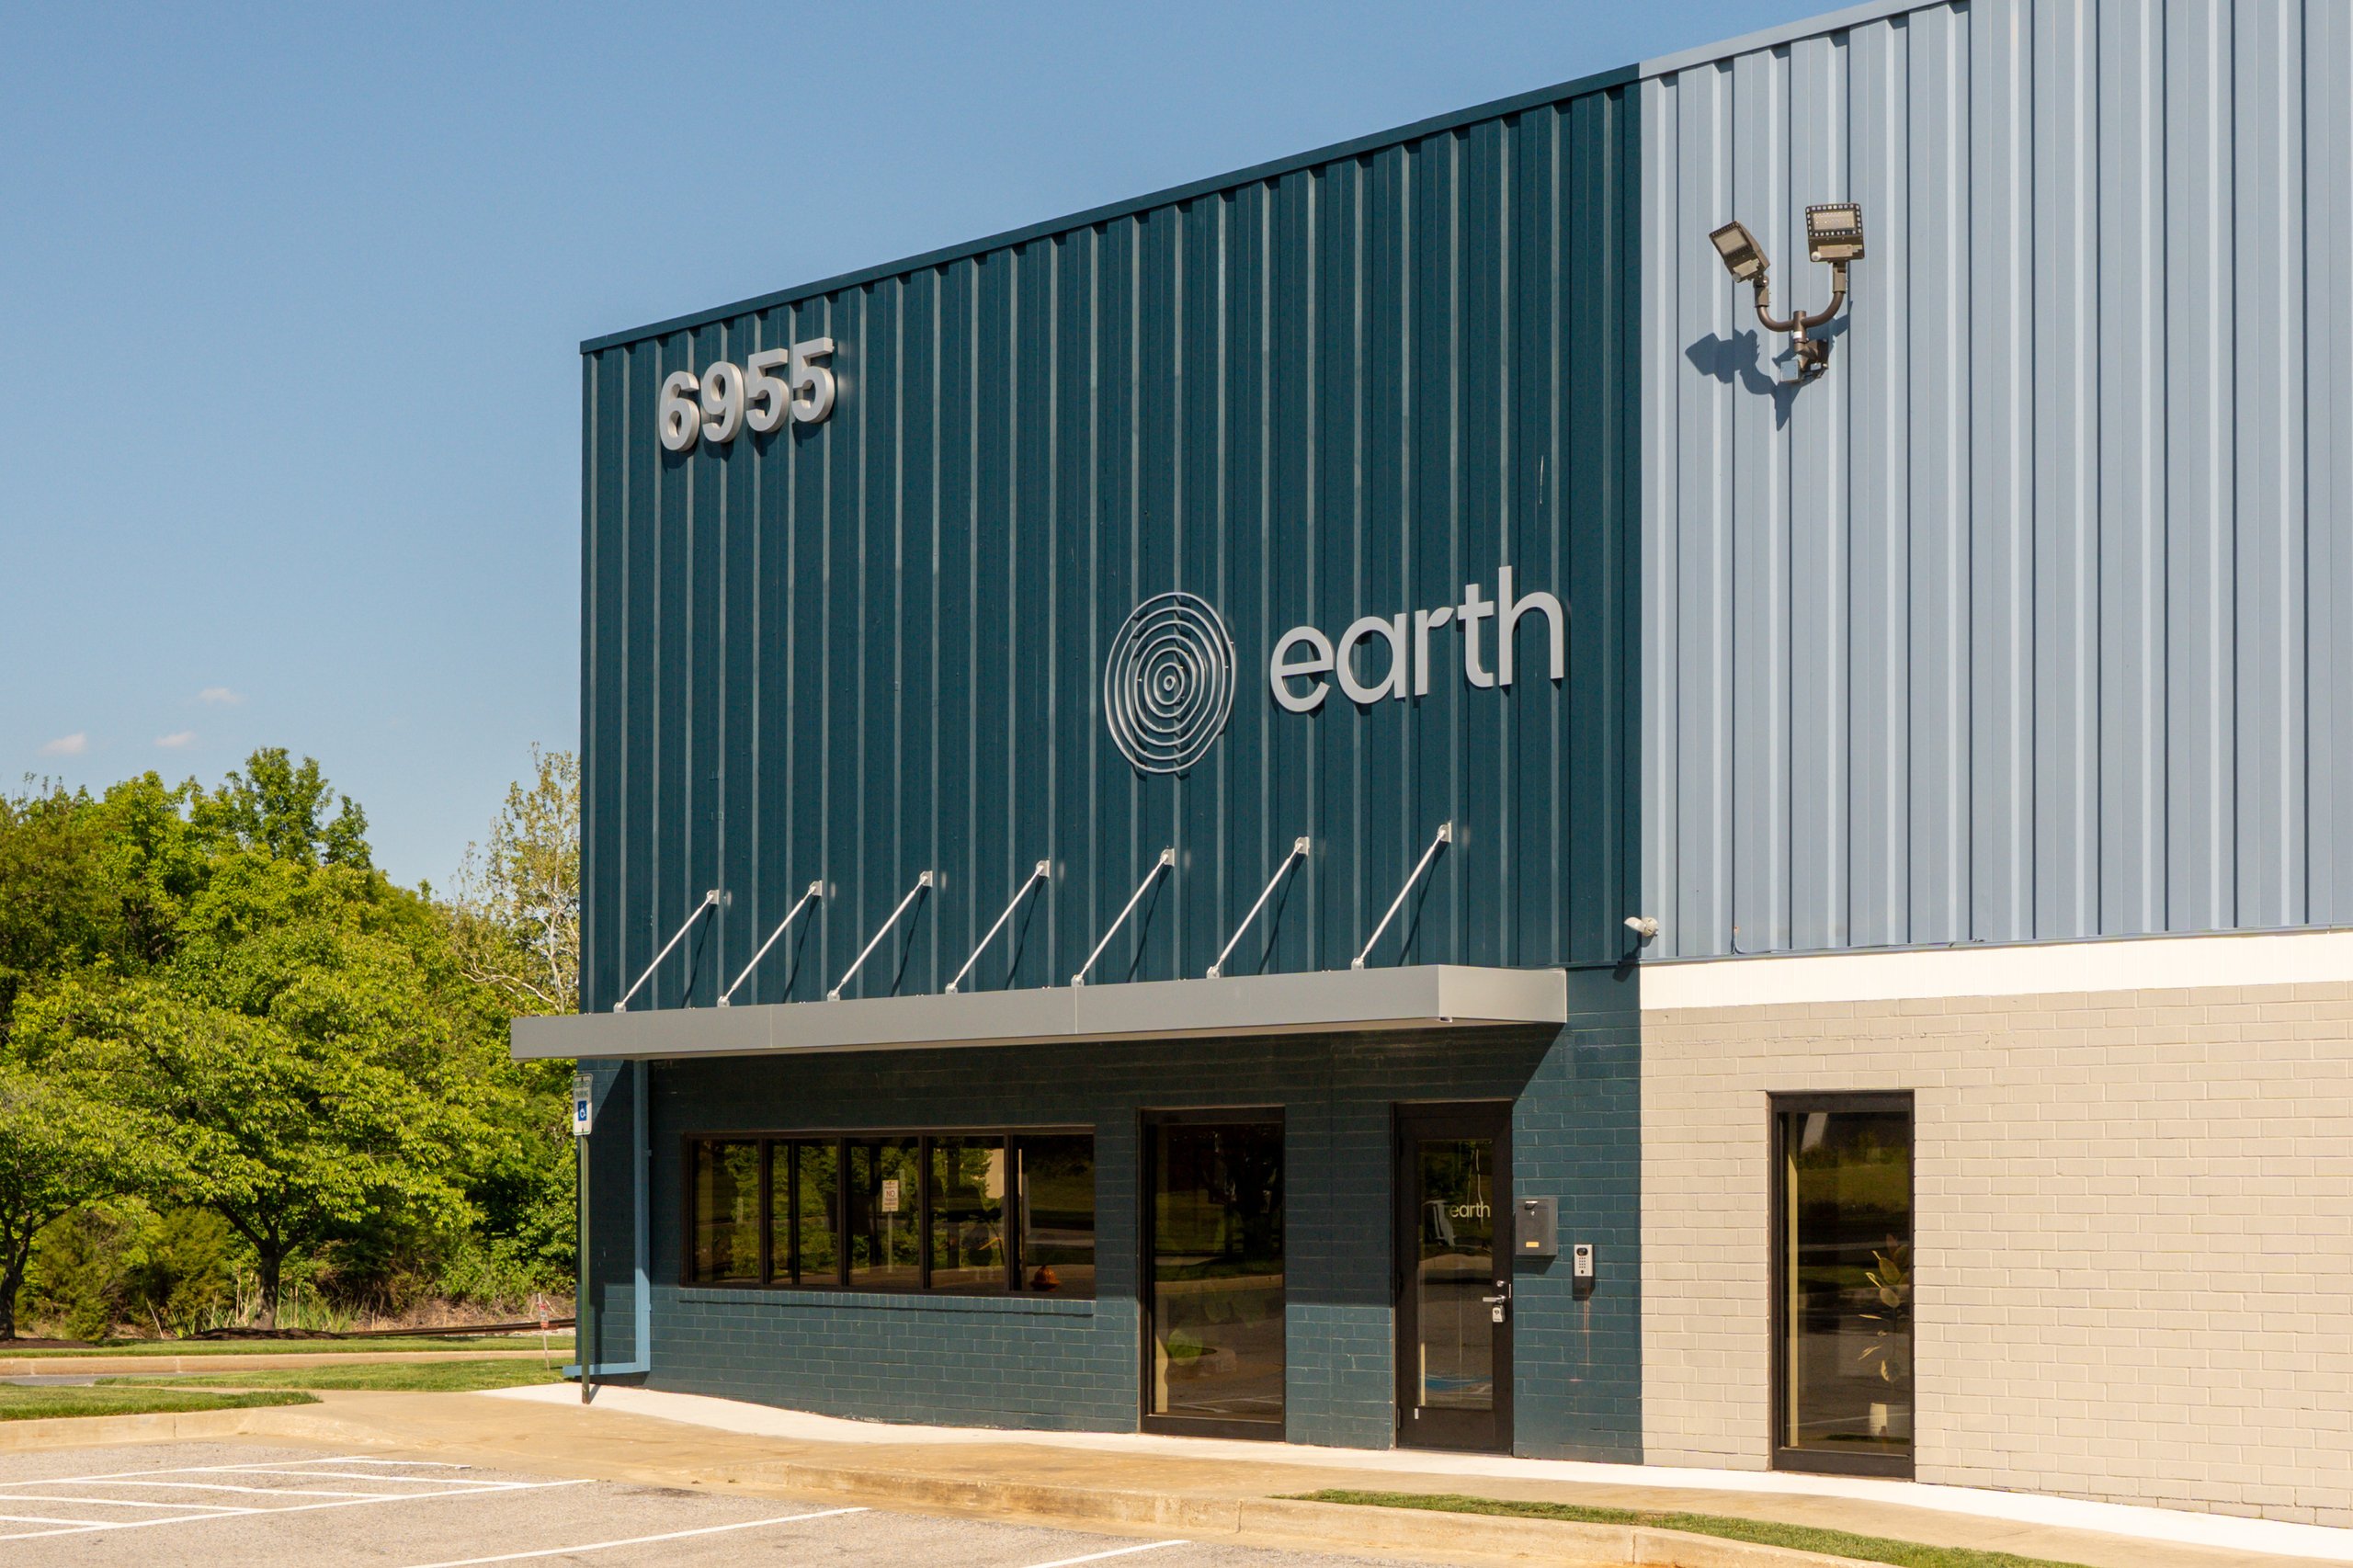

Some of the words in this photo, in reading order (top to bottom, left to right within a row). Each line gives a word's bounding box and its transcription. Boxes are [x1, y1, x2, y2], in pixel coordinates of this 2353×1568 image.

[659, 337, 835, 452] 6955
[1270, 565, 1564, 712] earth
[1449, 1201, 1491, 1218] earth
